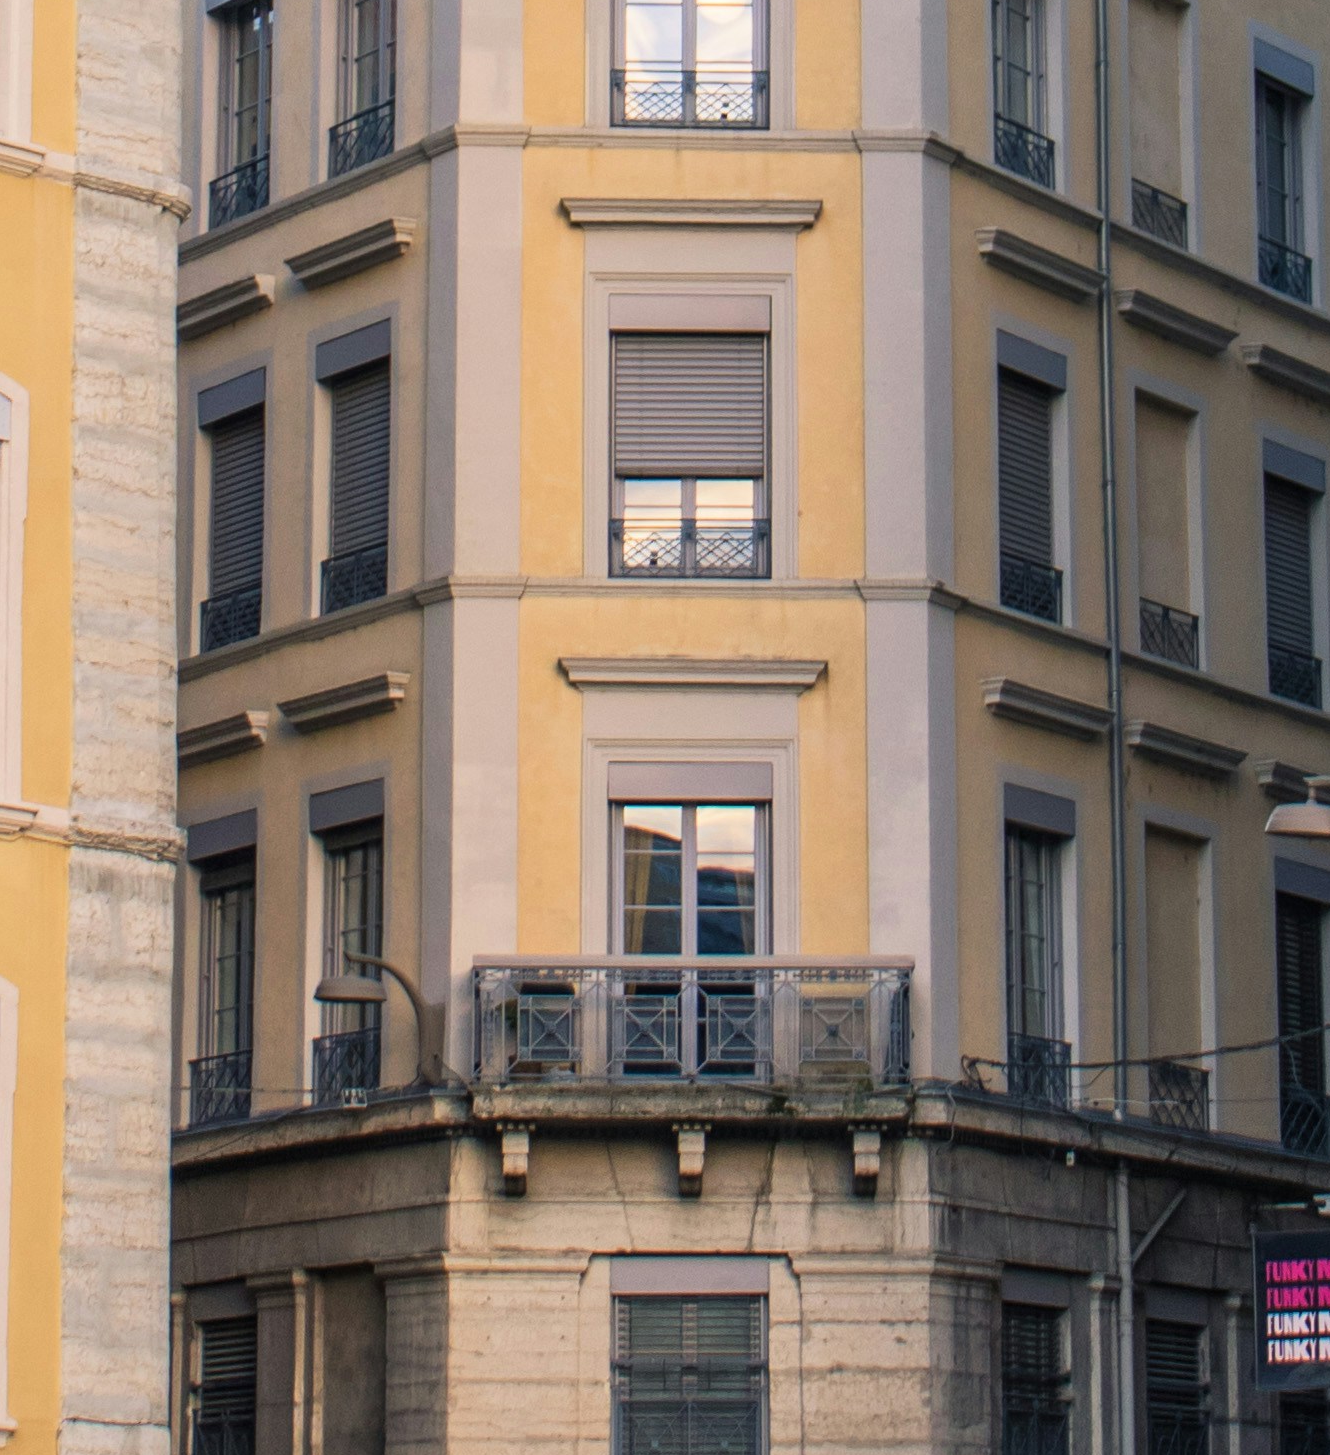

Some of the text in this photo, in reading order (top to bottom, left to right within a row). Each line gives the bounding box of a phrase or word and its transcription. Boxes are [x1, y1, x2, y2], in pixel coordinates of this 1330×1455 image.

[1267, 1259, 1314, 1283] FUNKY
[1267, 1286, 1315, 1309] FUNKY
[1268, 1311, 1316, 1336] FUNKY
[1268, 1338, 1316, 1363] FUNKY
